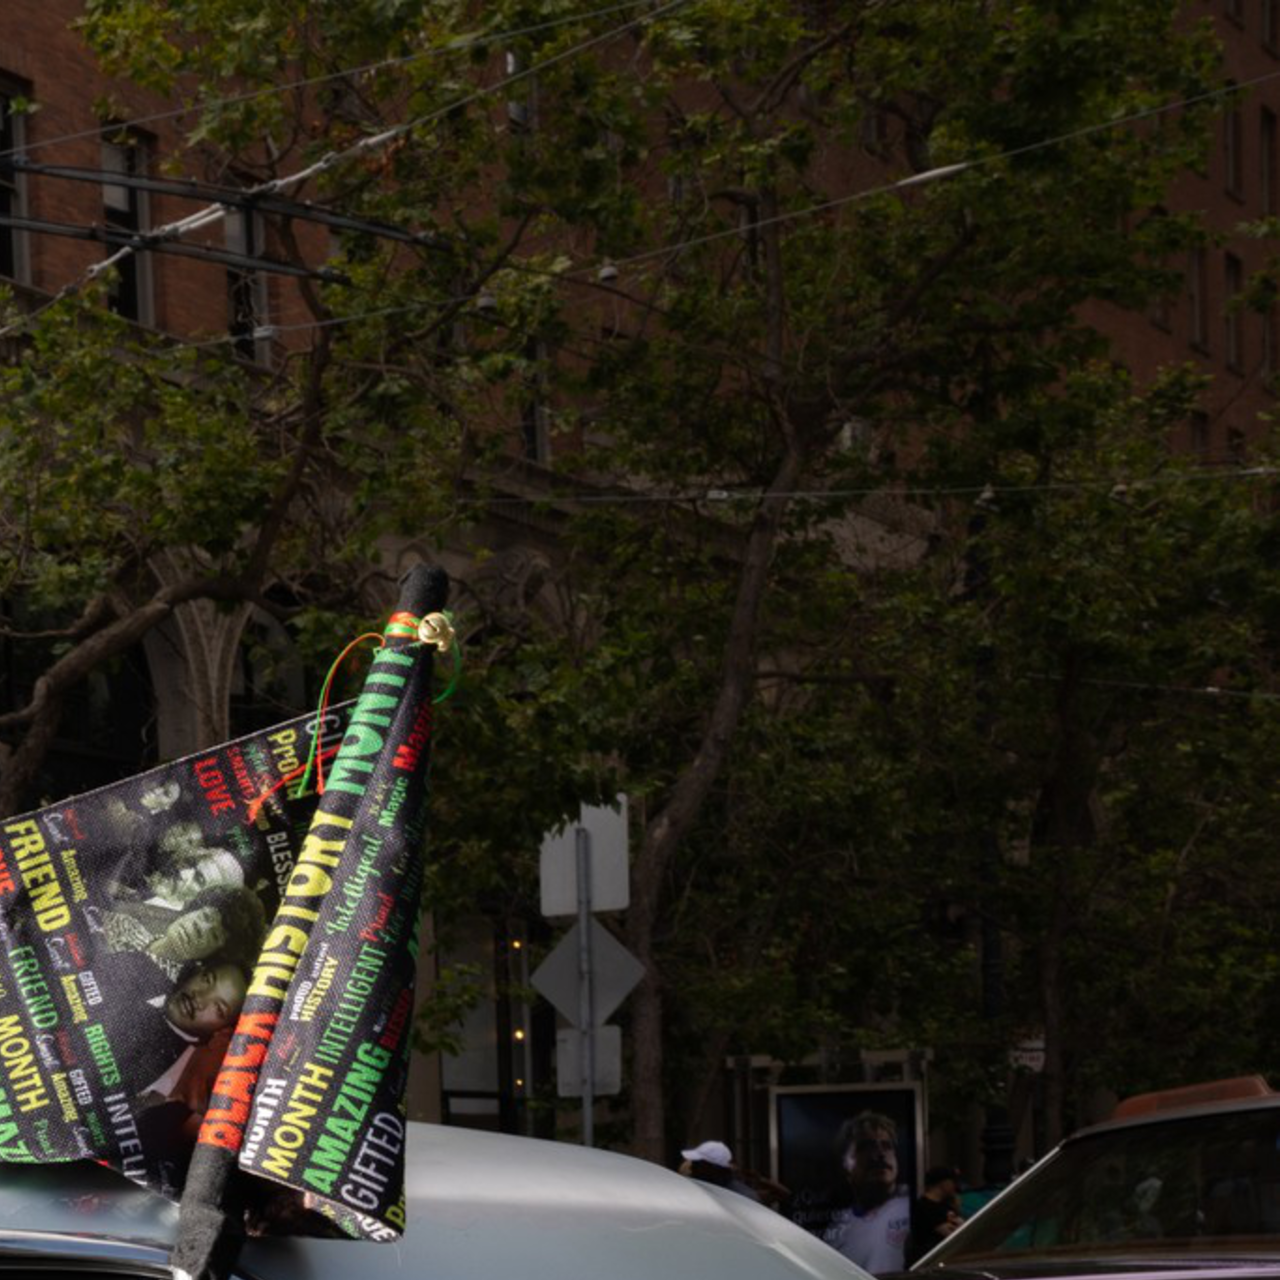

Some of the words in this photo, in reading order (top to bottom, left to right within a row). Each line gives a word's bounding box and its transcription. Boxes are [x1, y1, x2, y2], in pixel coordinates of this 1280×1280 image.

[191, 757, 236, 817] LOVE
[376, 775, 412, 828] Magic
[3, 818, 73, 934] FRIEND
[324, 833, 383, 931] Intelligent
[7, 945, 59, 1029] FRIEND
[196, 1011, 279, 1150] BLACK
[245, 808, 354, 1000] HISTORY
[298, 954, 339, 1021] HISTORY
[314, 941, 387, 1065] INTELLIGENT
[83, 1022, 121, 1087] RIGHTS
[238, 1077, 287, 1165] MONTH
[259, 1060, 334, 1179] MONTH
[300, 1038, 394, 1195] AMAZING
[339, 1108, 406, 1213] GIFTED
